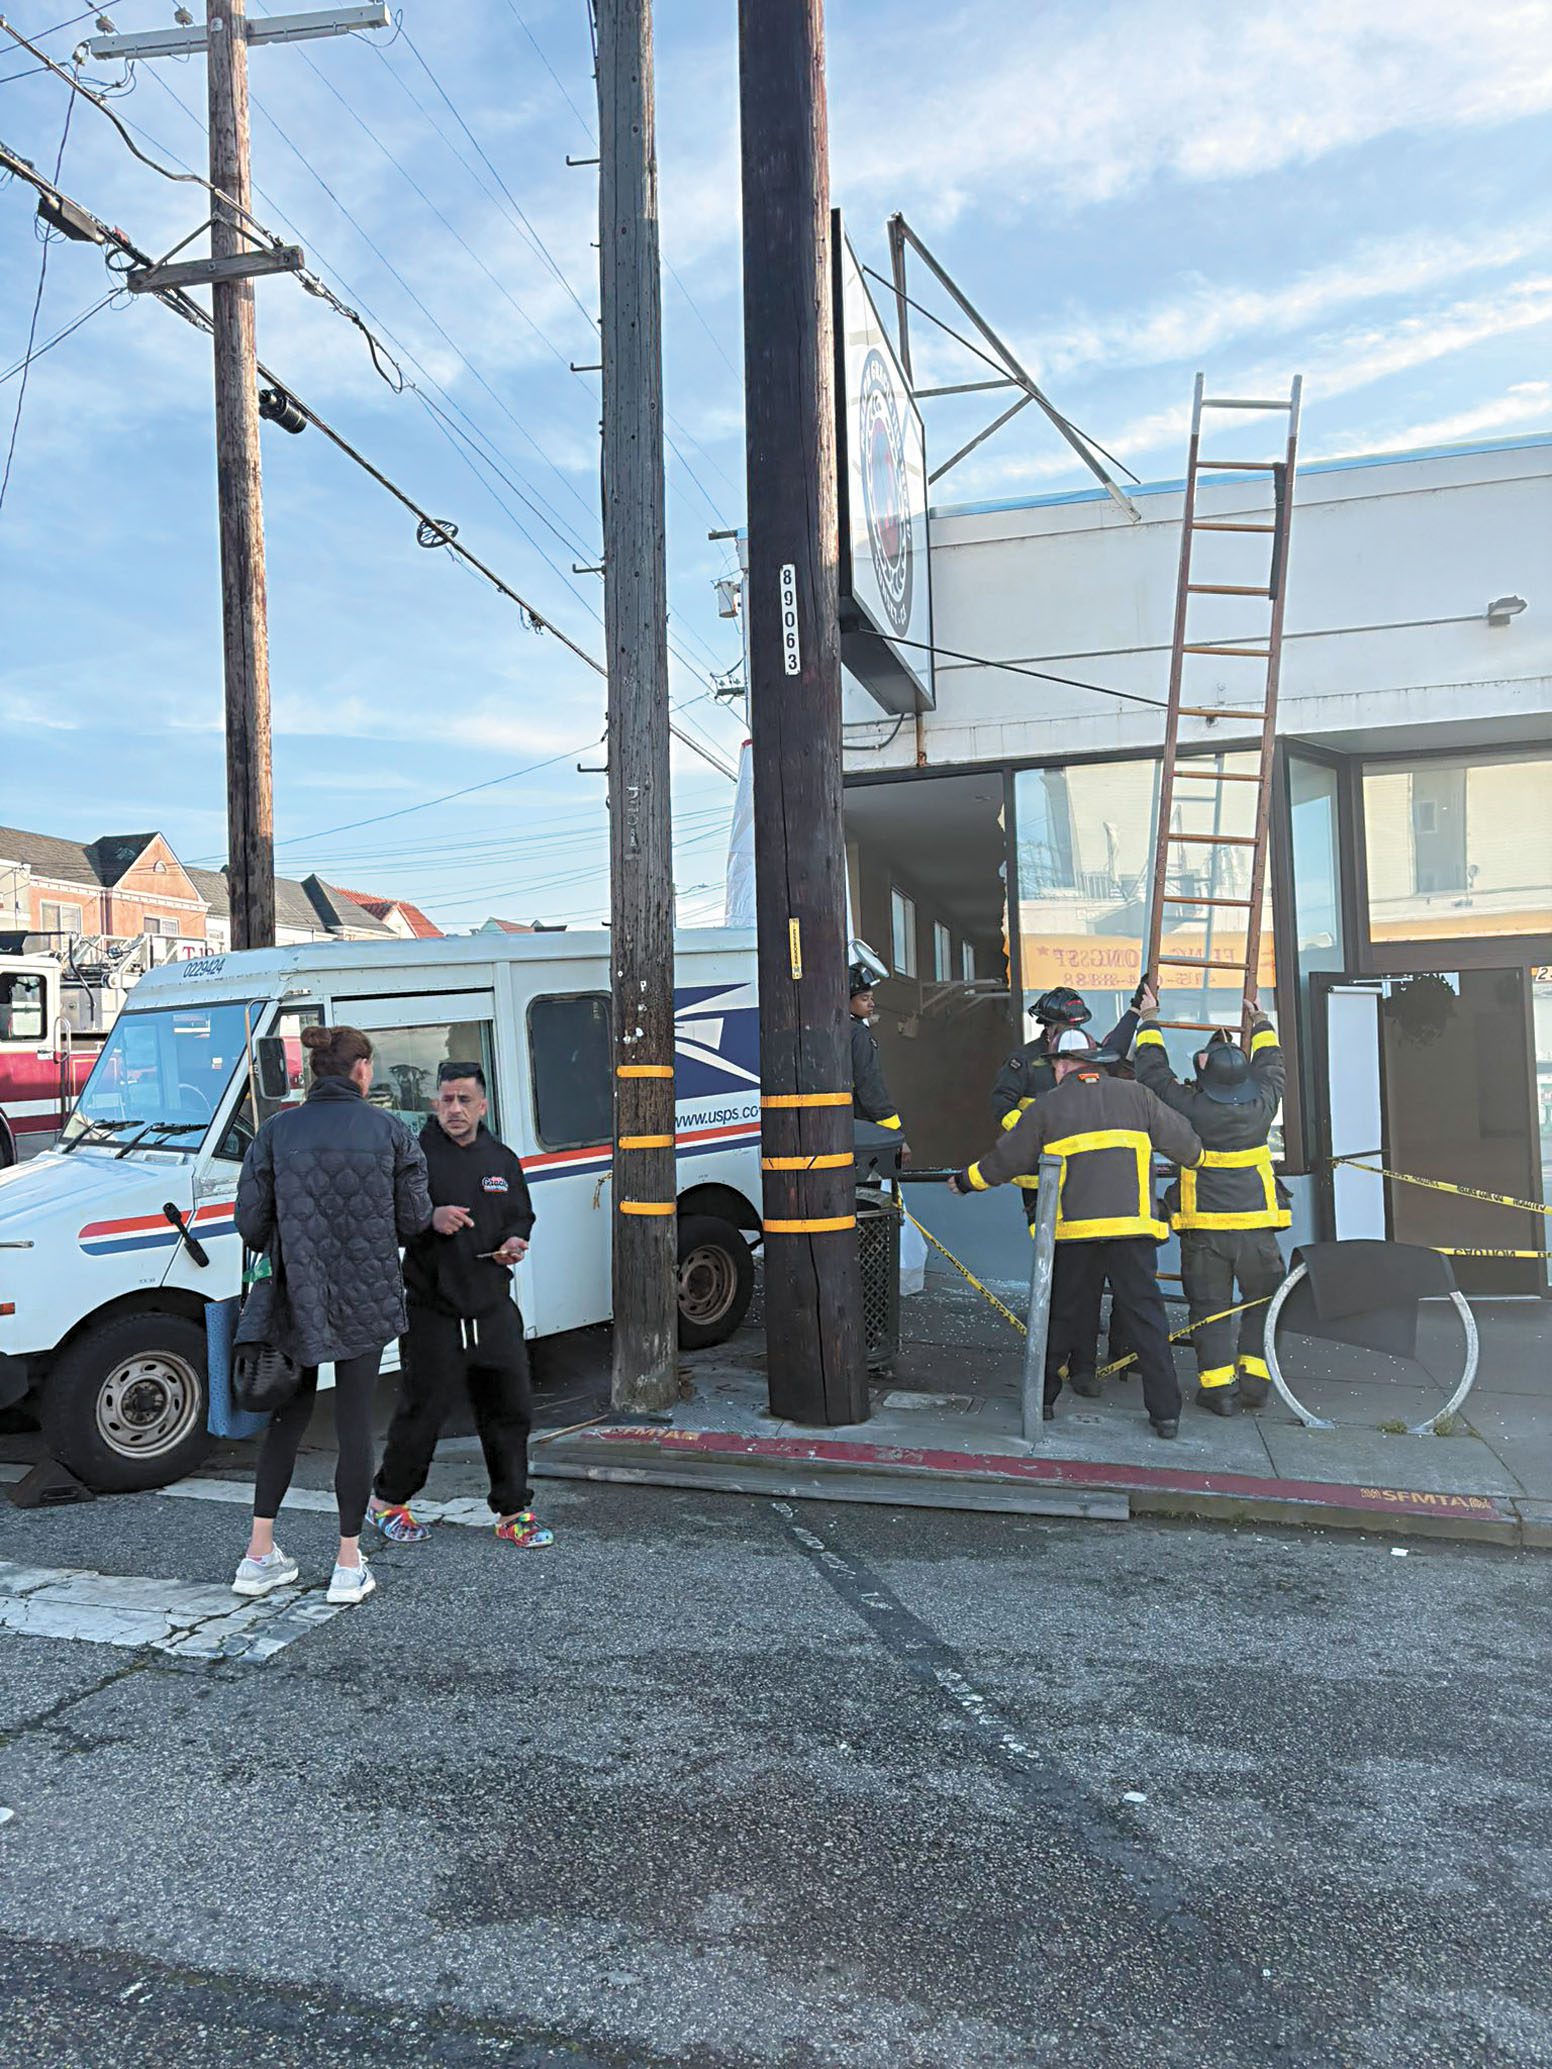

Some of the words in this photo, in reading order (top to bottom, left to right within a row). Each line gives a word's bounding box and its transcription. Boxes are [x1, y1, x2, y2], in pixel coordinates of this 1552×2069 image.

[783, 568, 797, 670] 89063
[1537, 967, 1552, 980] 2
[675, 1104, 761, 1128] www.usps.co
[1382, 1489, 1470, 1508] SFMTA
